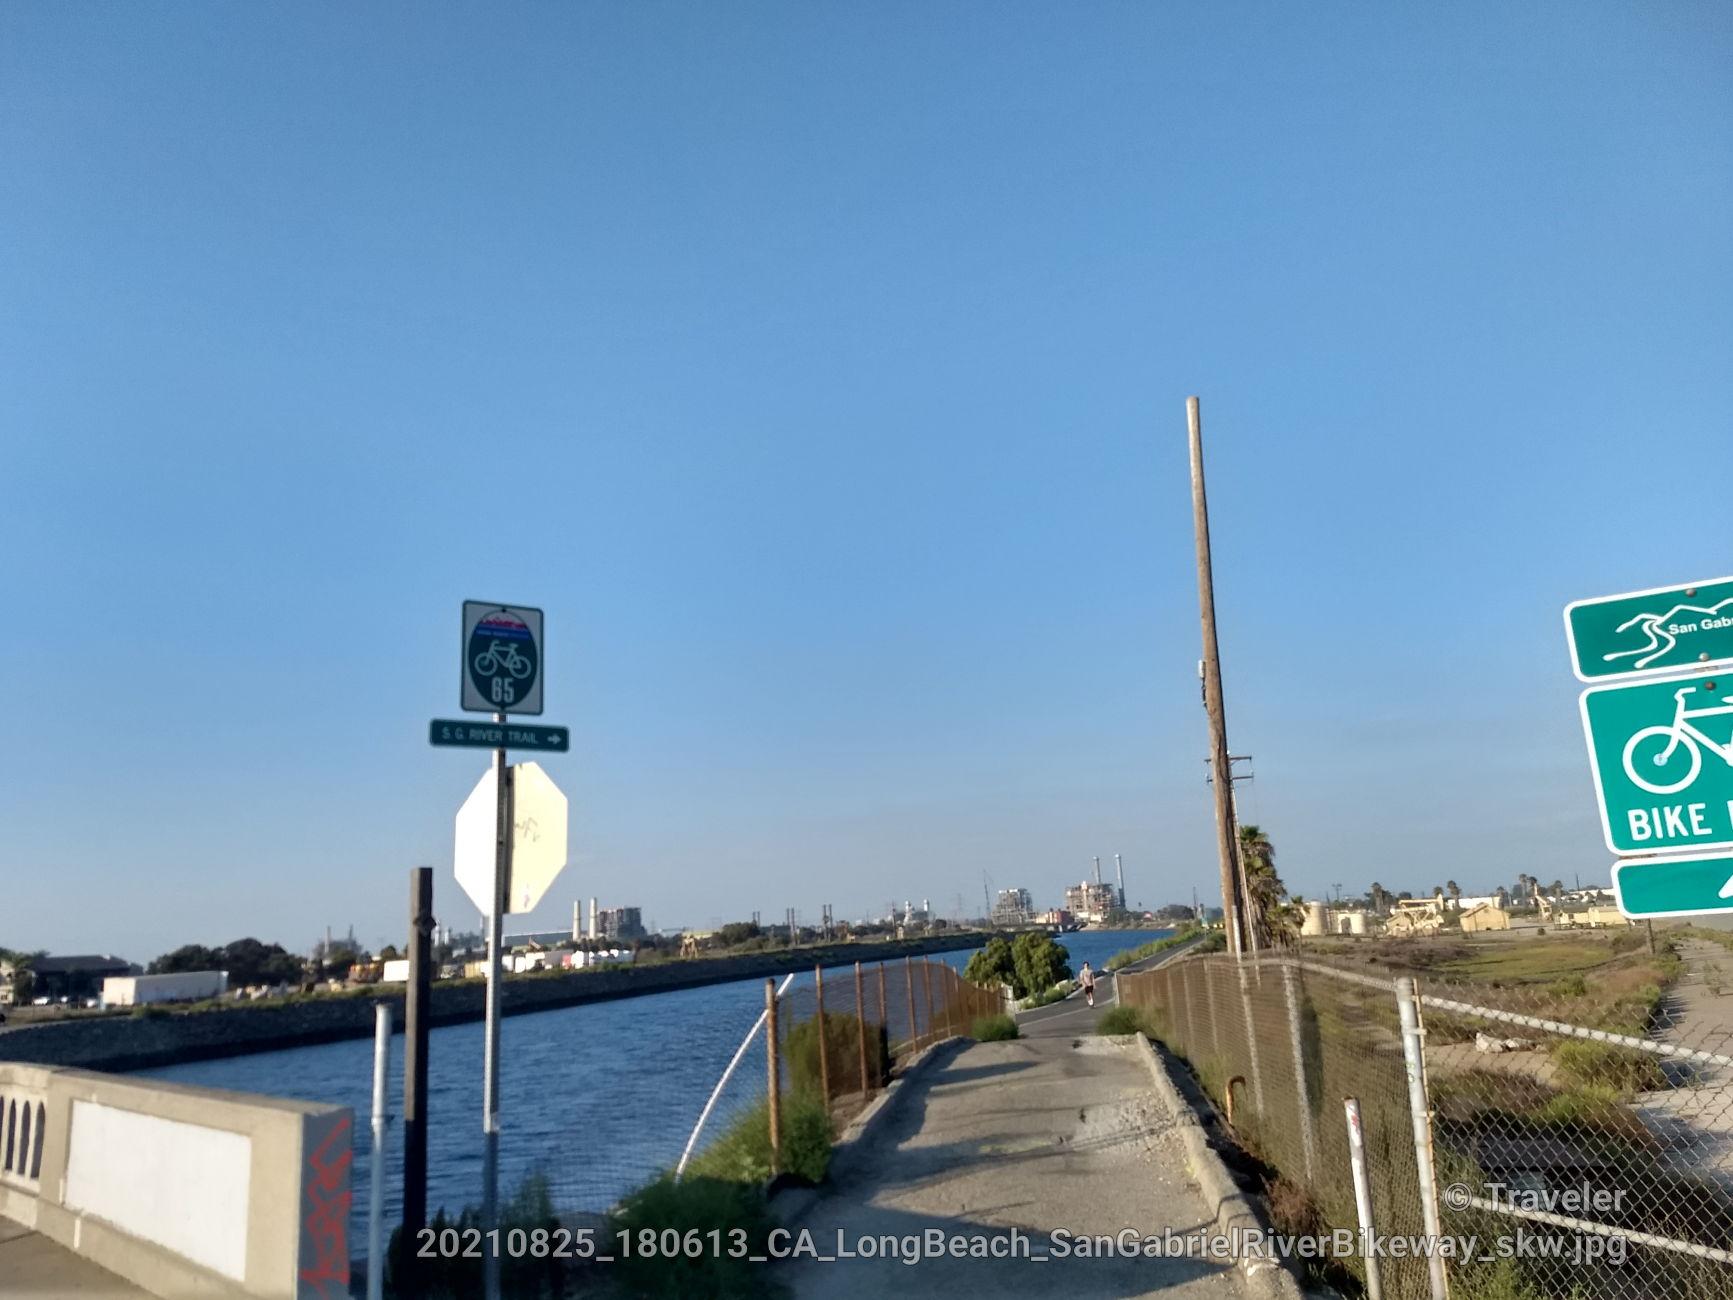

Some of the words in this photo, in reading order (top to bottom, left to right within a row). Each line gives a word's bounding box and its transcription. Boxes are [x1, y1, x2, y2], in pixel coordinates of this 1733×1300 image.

[1668, 623, 1698, 635] San
[1700, 616, 1733, 630] Gab
[468, 728, 503, 742] RIVER
[508, 730, 538, 744] TRAIL
[1627, 802, 1712, 842] BIKE
